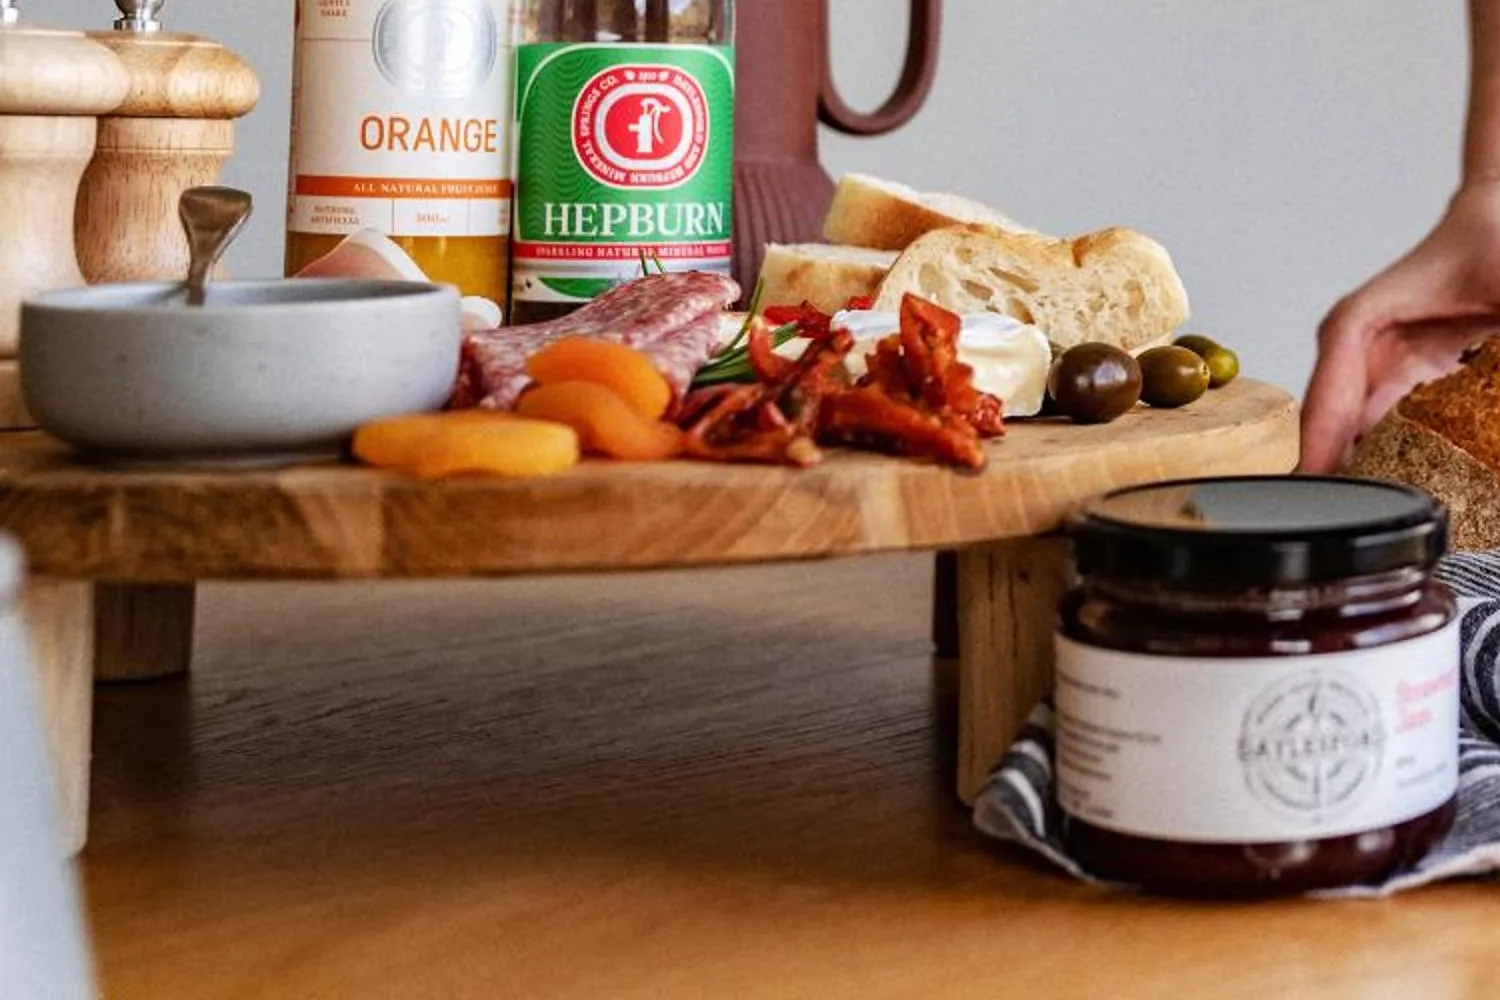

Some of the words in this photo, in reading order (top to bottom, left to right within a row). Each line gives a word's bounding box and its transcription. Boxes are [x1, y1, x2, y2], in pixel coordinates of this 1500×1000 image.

[361, 115, 498, 153] ORANGE
[353, 183, 376, 193] ALL
[543, 202, 724, 237] HEPBURN
